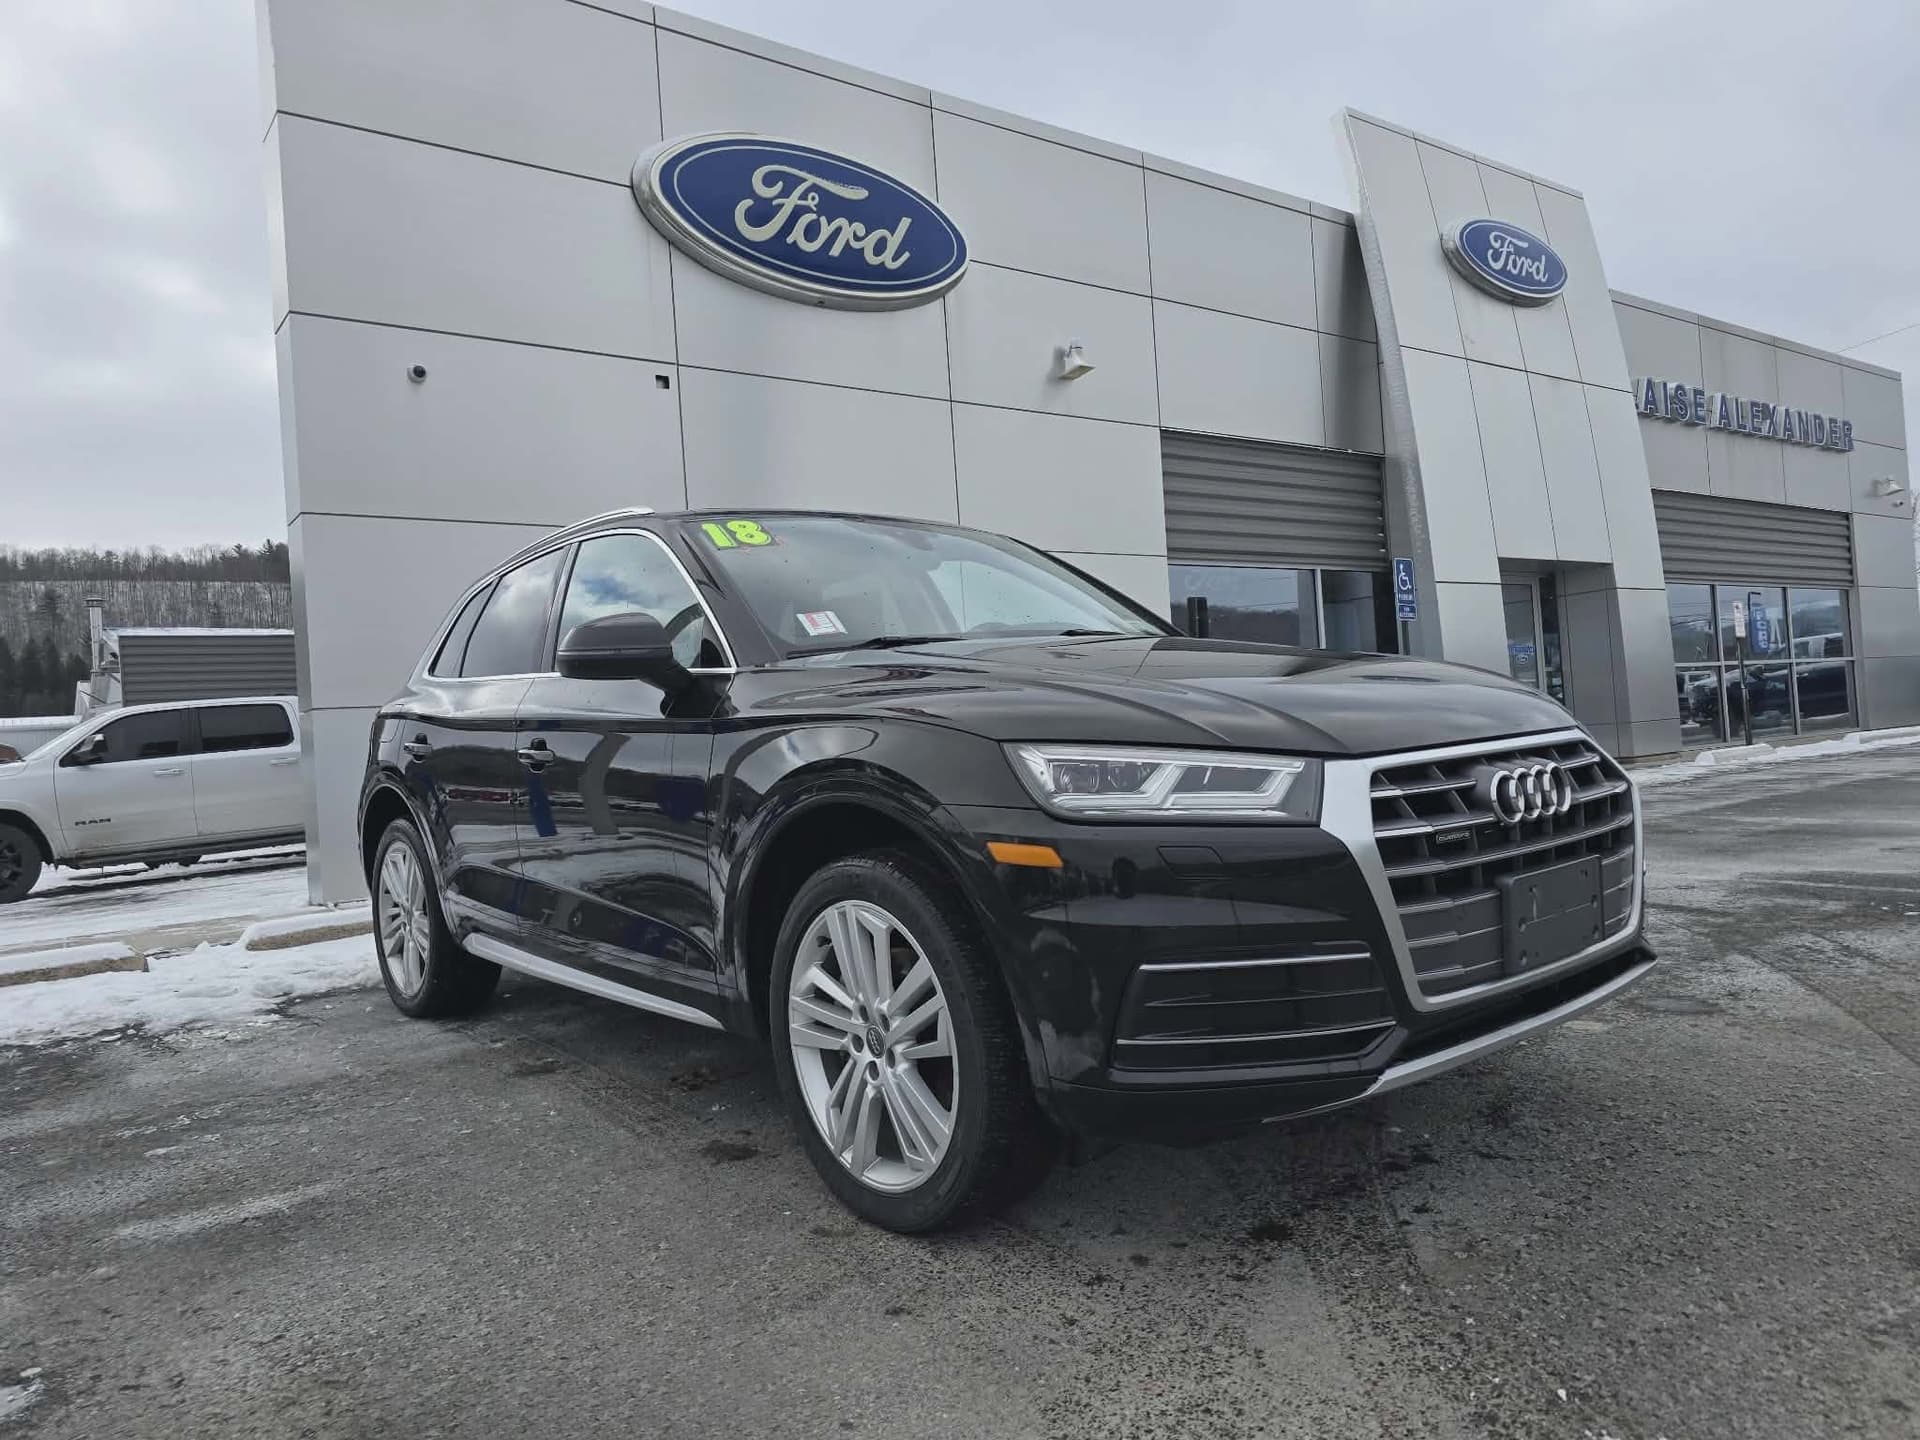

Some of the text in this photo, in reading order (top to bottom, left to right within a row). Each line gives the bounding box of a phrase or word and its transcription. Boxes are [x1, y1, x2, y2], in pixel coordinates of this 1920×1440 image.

[734, 165, 912, 270] Ford
[1487, 231, 1547, 282] Ford
[1634, 376, 1855, 451] AISE ALEXANDER
[702, 520, 772, 547] 18
